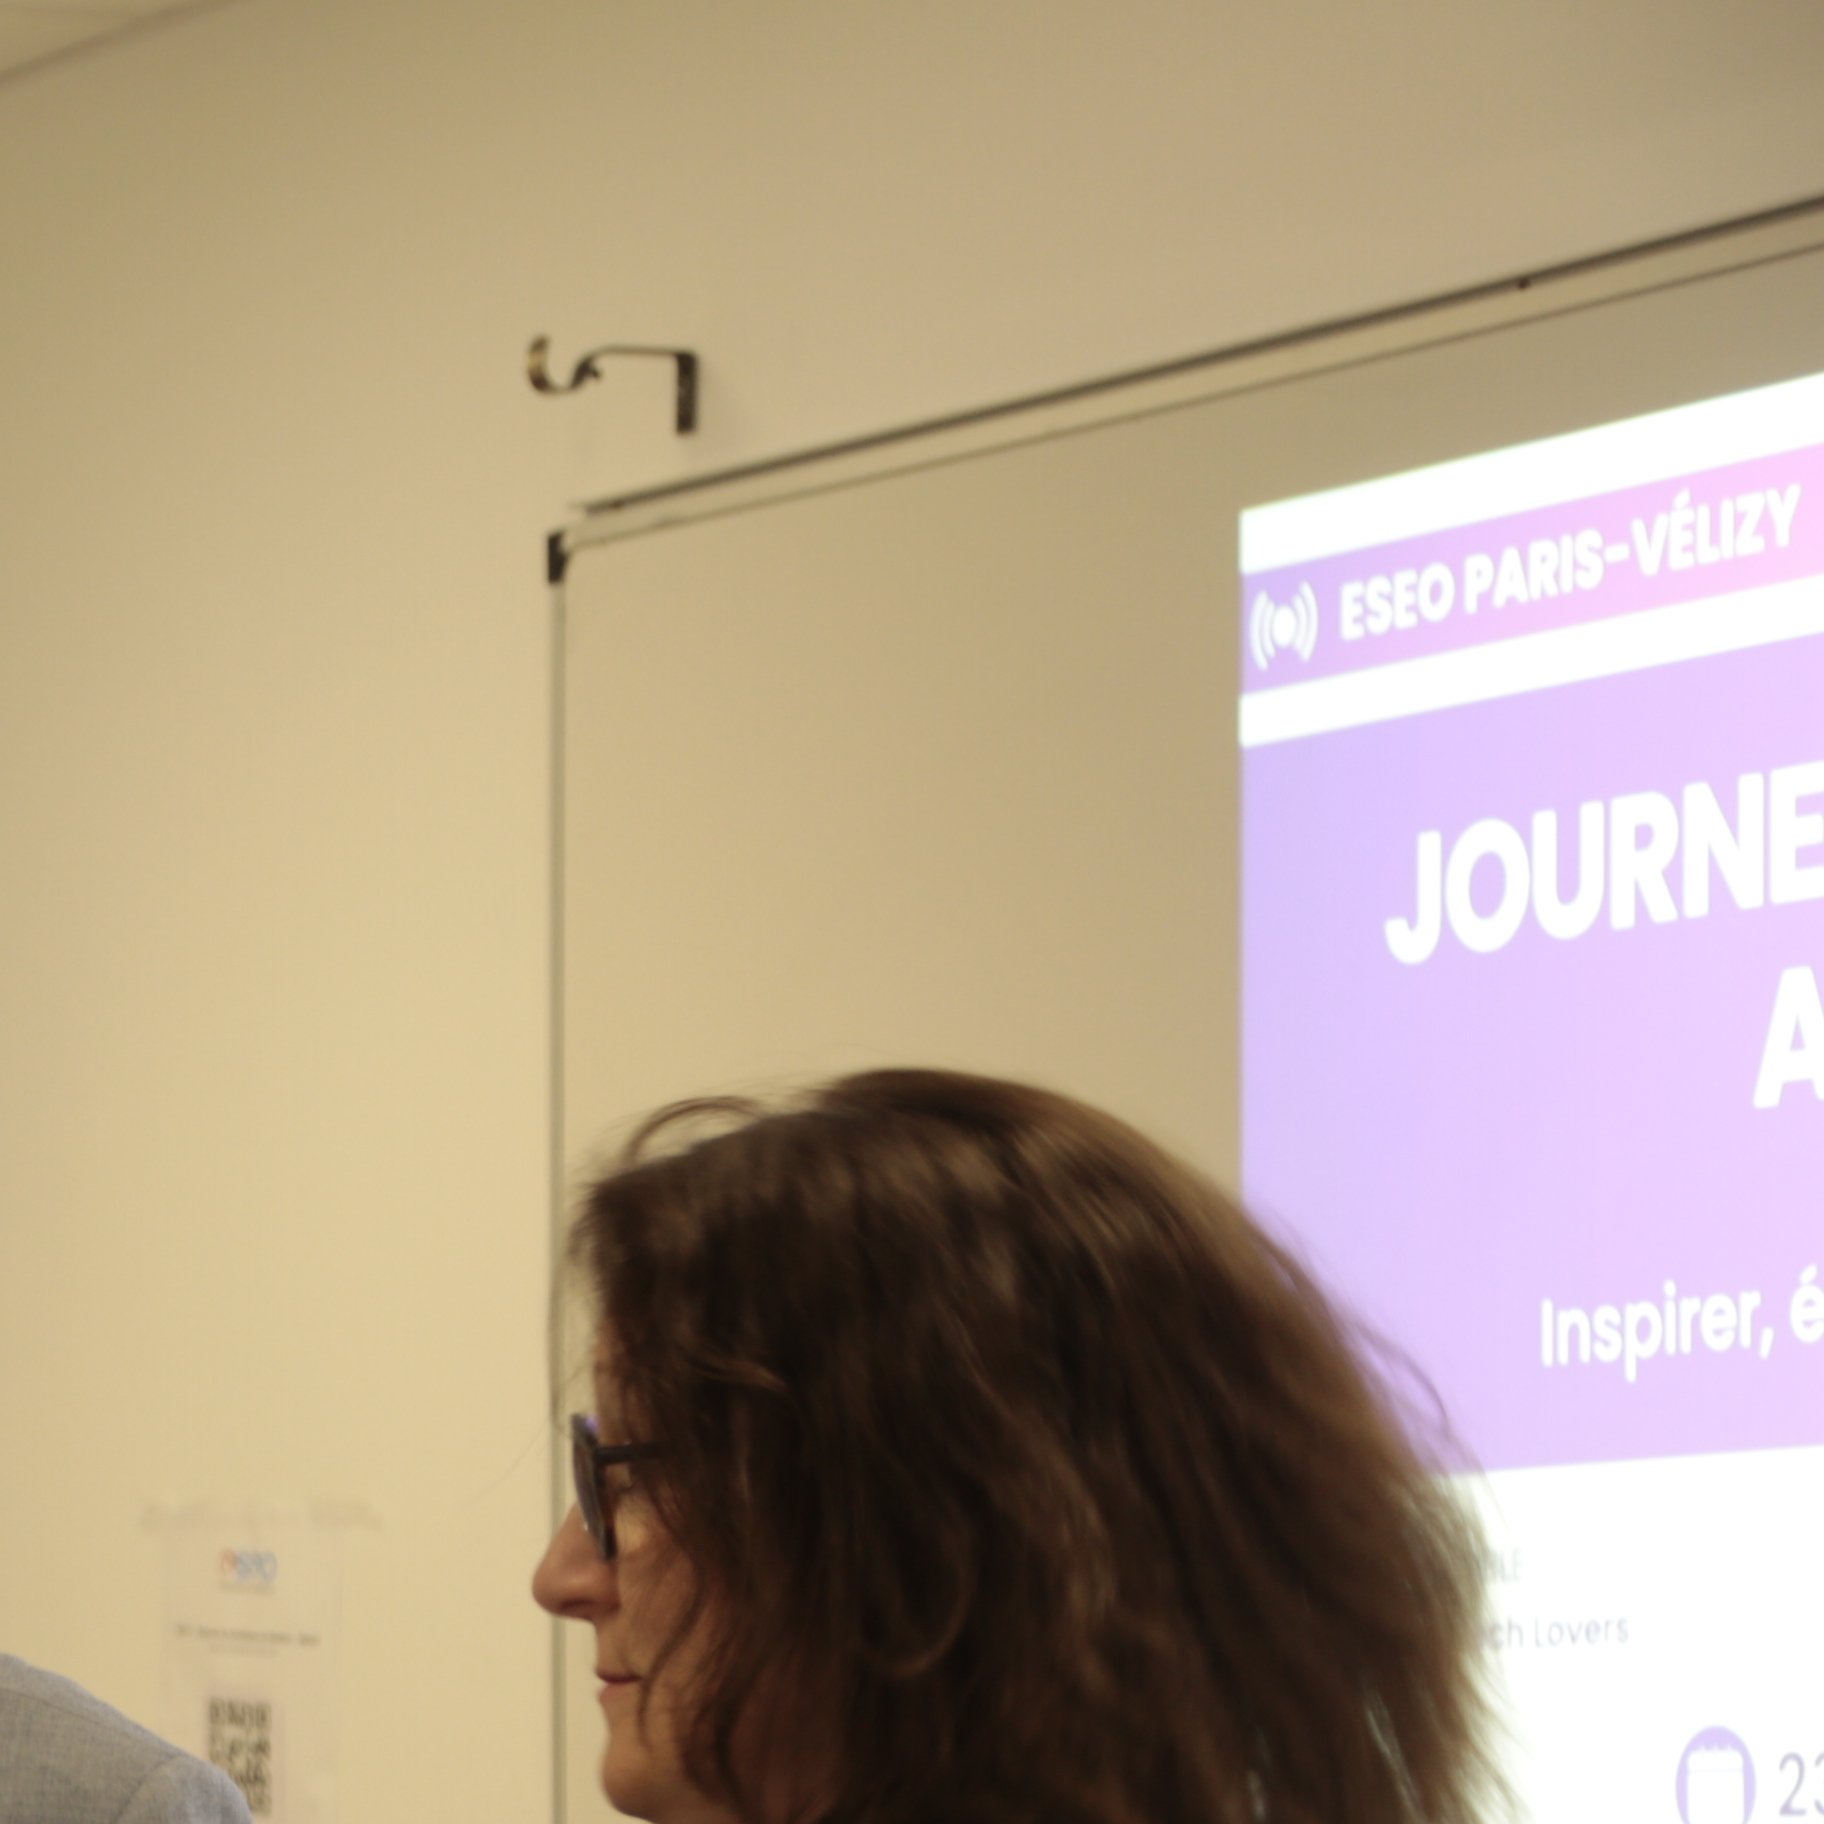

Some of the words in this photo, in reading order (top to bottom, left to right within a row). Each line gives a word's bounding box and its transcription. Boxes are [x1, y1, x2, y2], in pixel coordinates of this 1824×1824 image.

[1340, 563, 1455, 642] ESEO
[1463, 483, 1802, 616] PARIS-VÉLIZY
[1384, 760, 1824, 965] JOURNE
[1540, 1279, 1774, 1383] Inspirer,
[1534, 1617, 1630, 1650] Lovers
